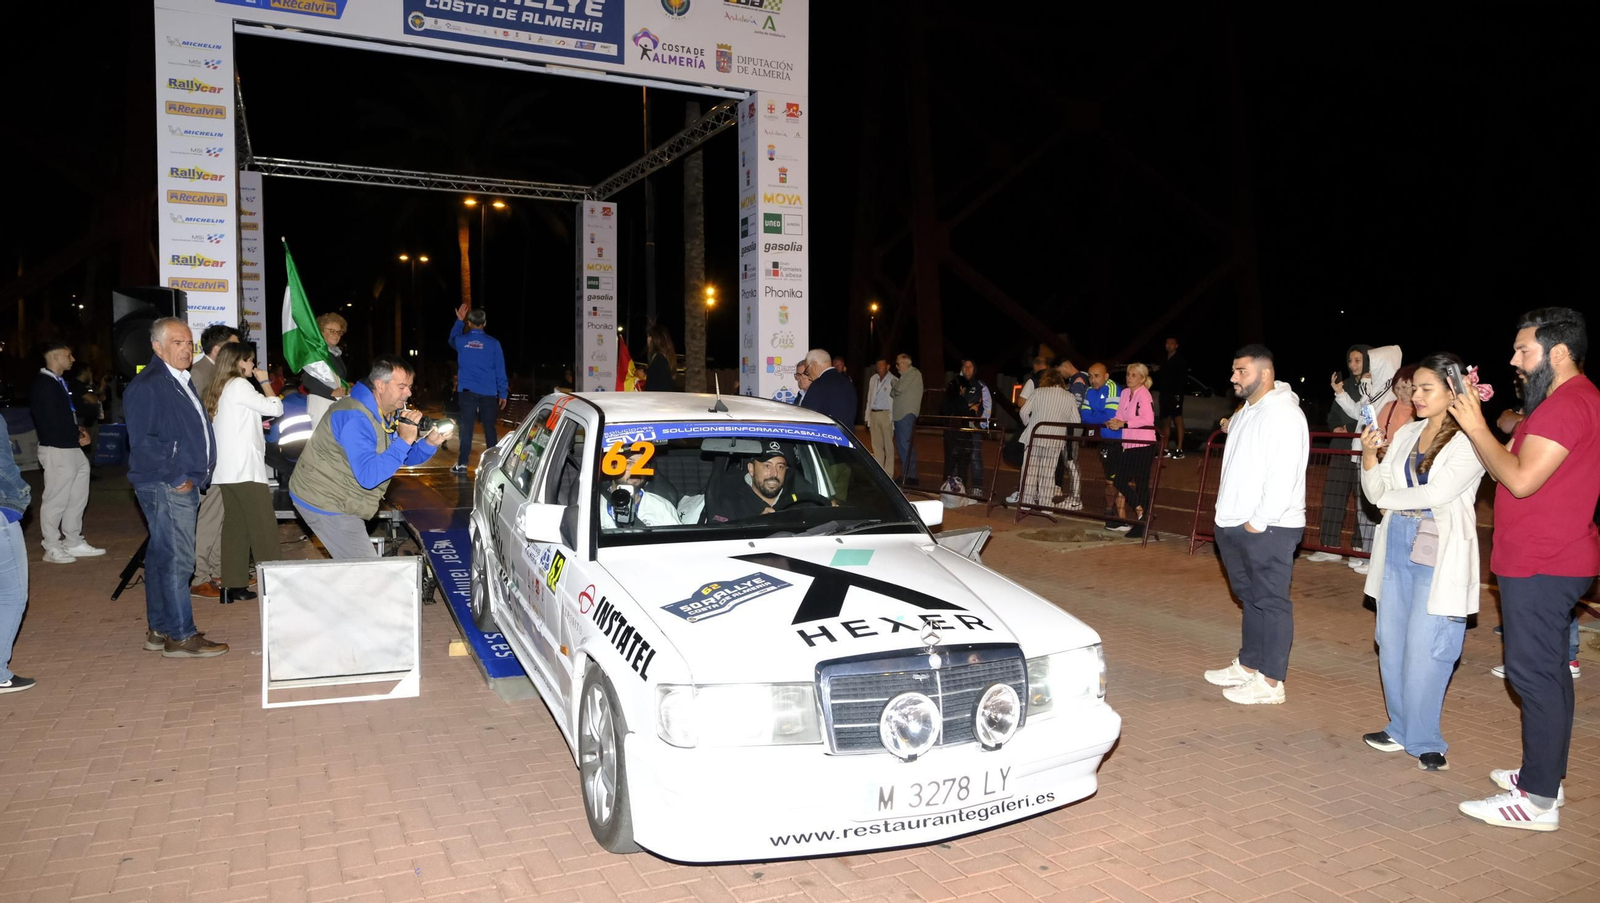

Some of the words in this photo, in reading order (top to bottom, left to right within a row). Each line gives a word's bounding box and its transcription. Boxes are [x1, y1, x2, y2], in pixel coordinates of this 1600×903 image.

[282, 0, 325, 12] Recalvi
[425, 0, 488, 17] COSTA
[493, 8, 516, 21] DE
[521, 11, 604, 33] ALMERÍA
[181, 40, 223, 50] MICHELIN
[662, 43, 692, 55] COSTA
[693, 48, 705, 56] DE
[652, 52, 706, 70] ALMERÍA
[737, 55, 793, 71] DIPUTACIÓN
[737, 65, 749, 74] DE
[751, 68, 791, 81] ALMERÍA
[168, 78, 224, 94] Rallycar
[177, 104, 214, 116] Recalvi
[183, 129, 224, 138] MICHELIN
[170, 167, 225, 182] Rallycar
[179, 193, 215, 204] Recalvi
[185, 216, 225, 224] MICHELIN
[764, 242, 803, 253] gasolia
[171, 255, 227, 268] Rallycar
[180, 280, 216, 290] Recalvi
[765, 286, 803, 299] Phonika
[587, 321, 613, 330] Phonika
[662, 426, 843, 442] SOLUCIONESINFORMATICASMJ.COM
[601, 441, 656, 476] 62
[701, 583, 722, 596] 62
[688, 603, 719, 616] COSTA
[719, 594, 732, 604] DE
[796, 613, 995, 648] HEXER
[592, 595, 657, 682] INSTATEL
[877, 784, 895, 812] M
[908, 775, 971, 808] 3278
[983, 765, 1012, 796] LY
[769, 790, 1056, 847] www.restaurantegaleri.es
